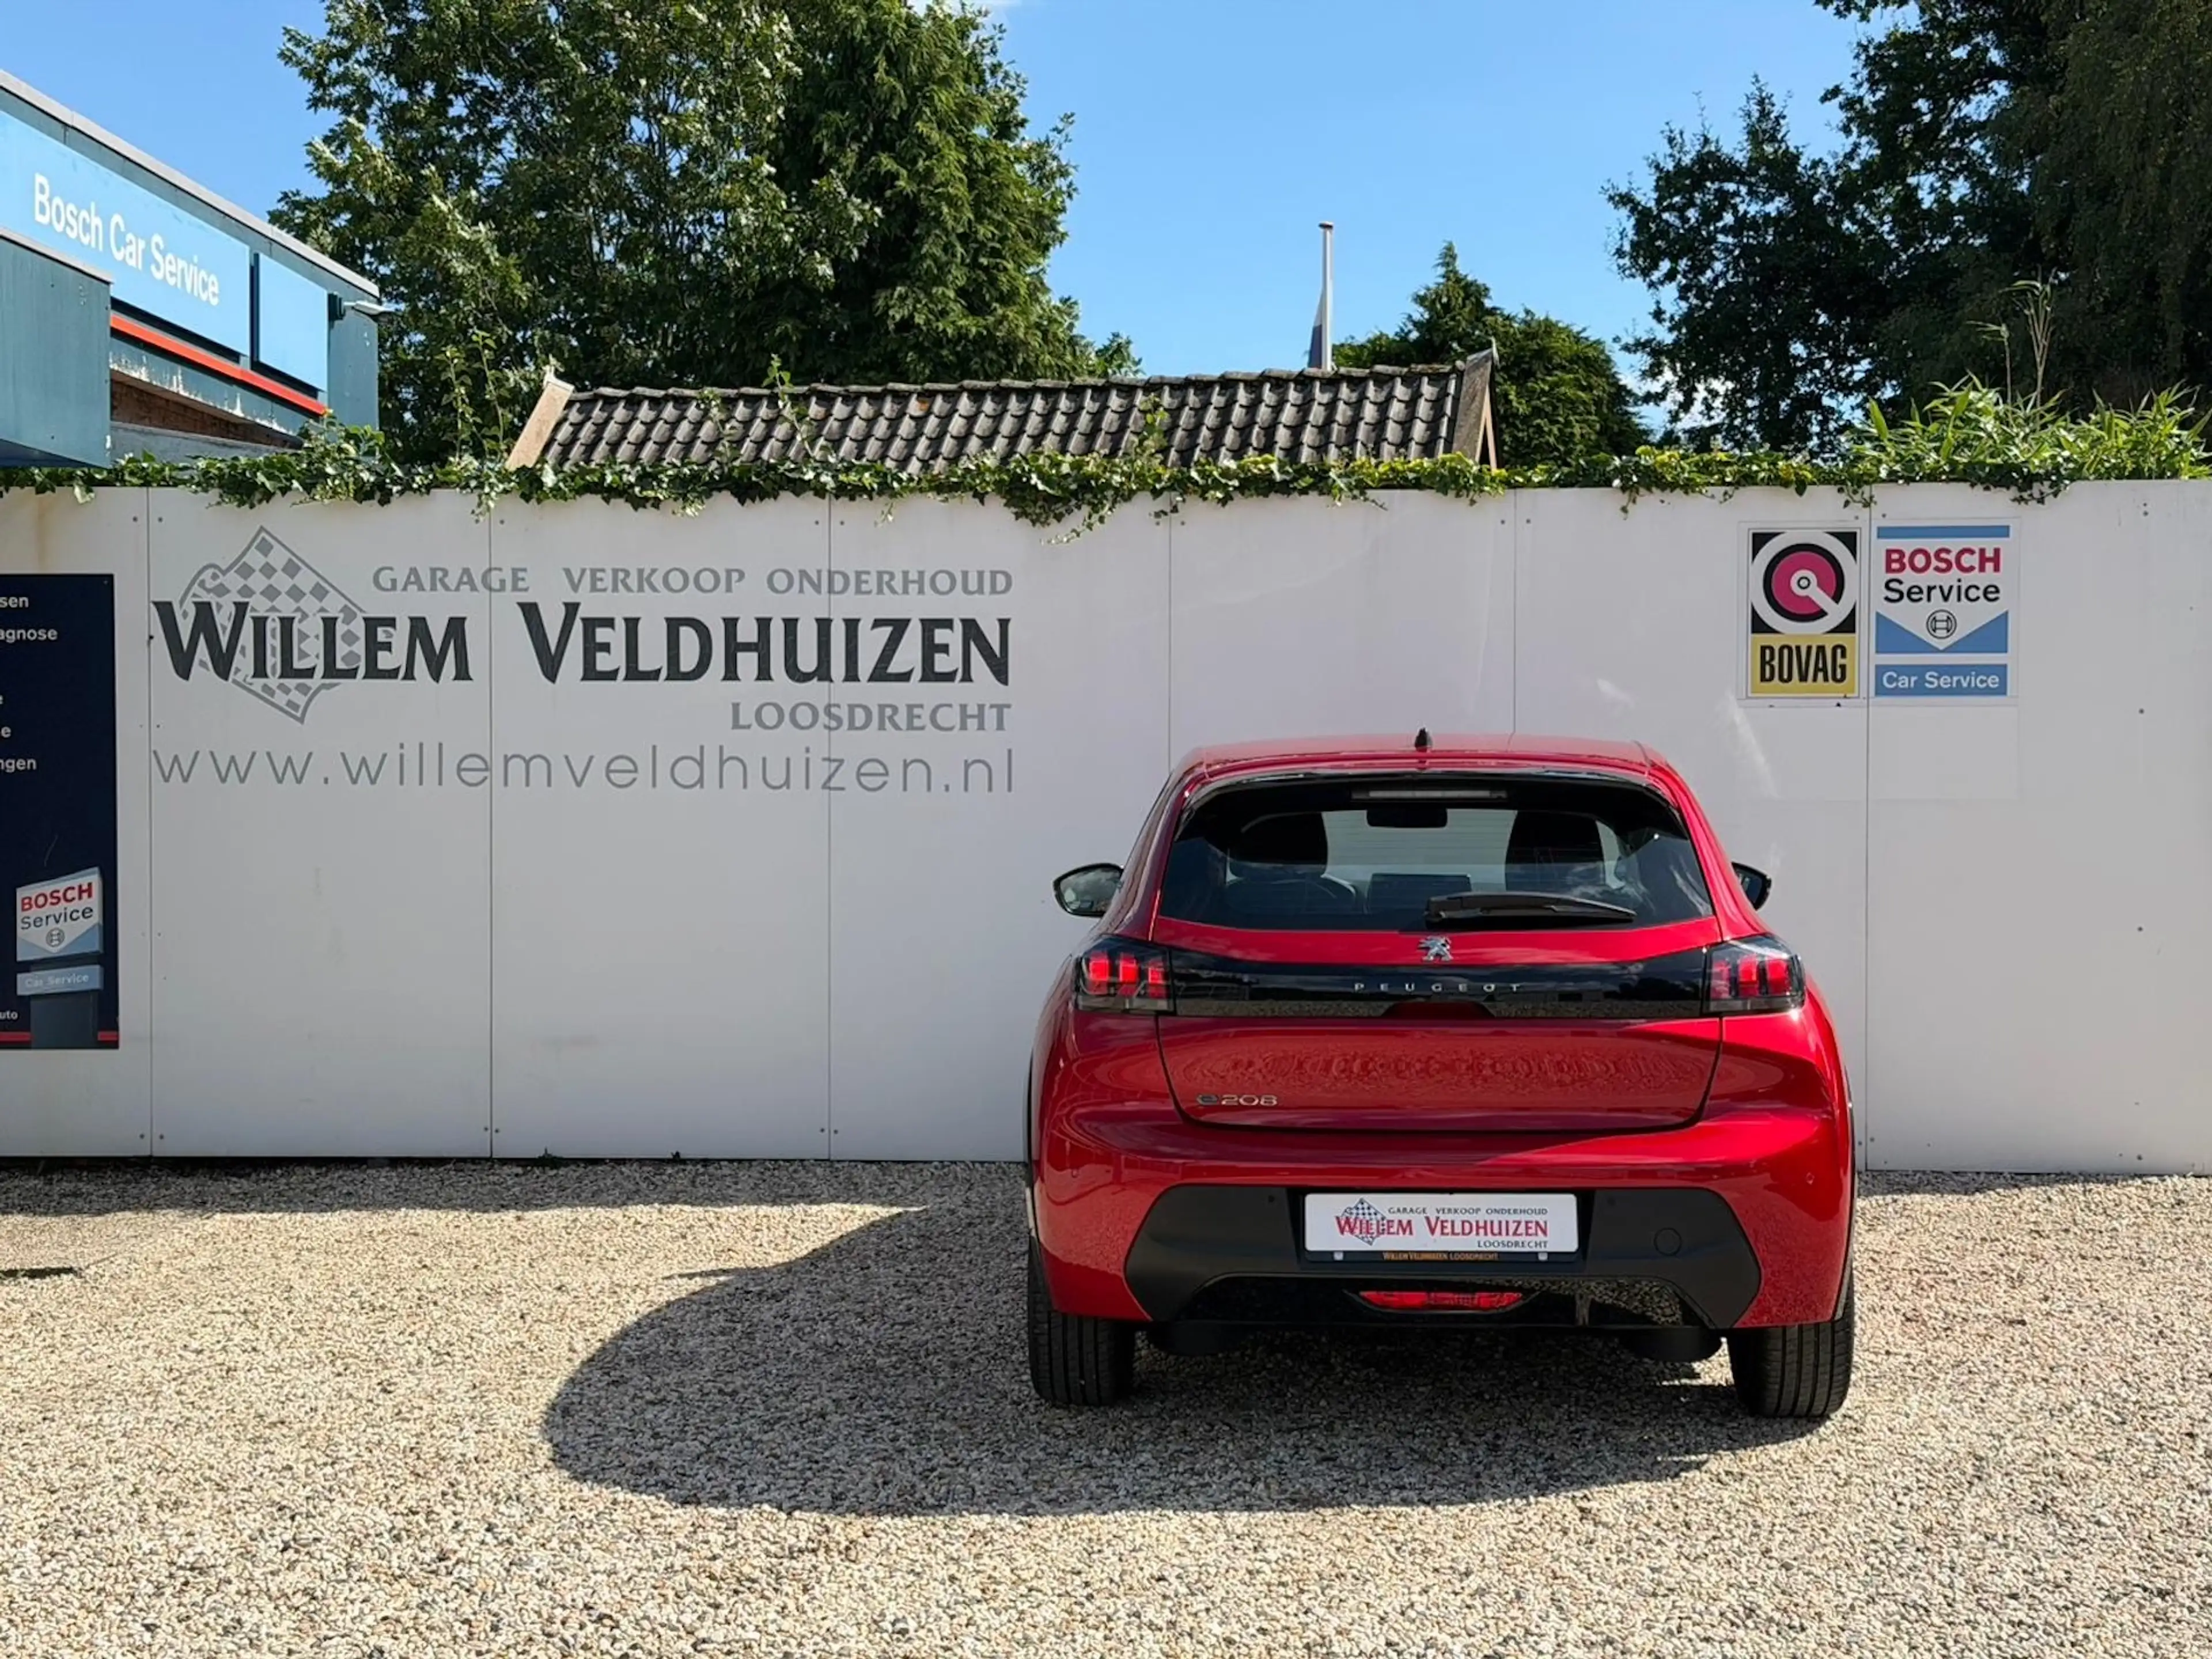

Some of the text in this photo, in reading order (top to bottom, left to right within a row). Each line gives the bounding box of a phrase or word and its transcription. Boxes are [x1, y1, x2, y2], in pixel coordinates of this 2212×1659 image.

[33, 173, 219, 306] Bosch Car Service
[1885, 547, 2002, 575] BOSCH
[372, 566, 1013, 596] GARAGE VERKOOP ONDERHOUD
[1883, 578, 2001, 604] Service
[151, 600, 1012, 687] WILLEM VELDHUIZEN
[1759, 643, 1848, 684] BOVAG
[1883, 671, 1999, 689] Car Service
[730, 702, 1013, 732] LOOSDRECHT
[153, 743, 1013, 794] www.willemveldhuizen.nl
[21, 882, 94, 912] BOSCH
[21, 906, 94, 930] Service
[47, 973, 89, 985] Service
[1354, 983, 1521, 992] PEUGEOT
[1388, 1206, 1427, 1215] GARAGE
[1485, 1208, 1548, 1216] ONDERHOUD
[1335, 1216, 1549, 1238] WILLEM VELDHUIZEN
[1477, 1240, 1548, 1249] LOOSDRECHT
